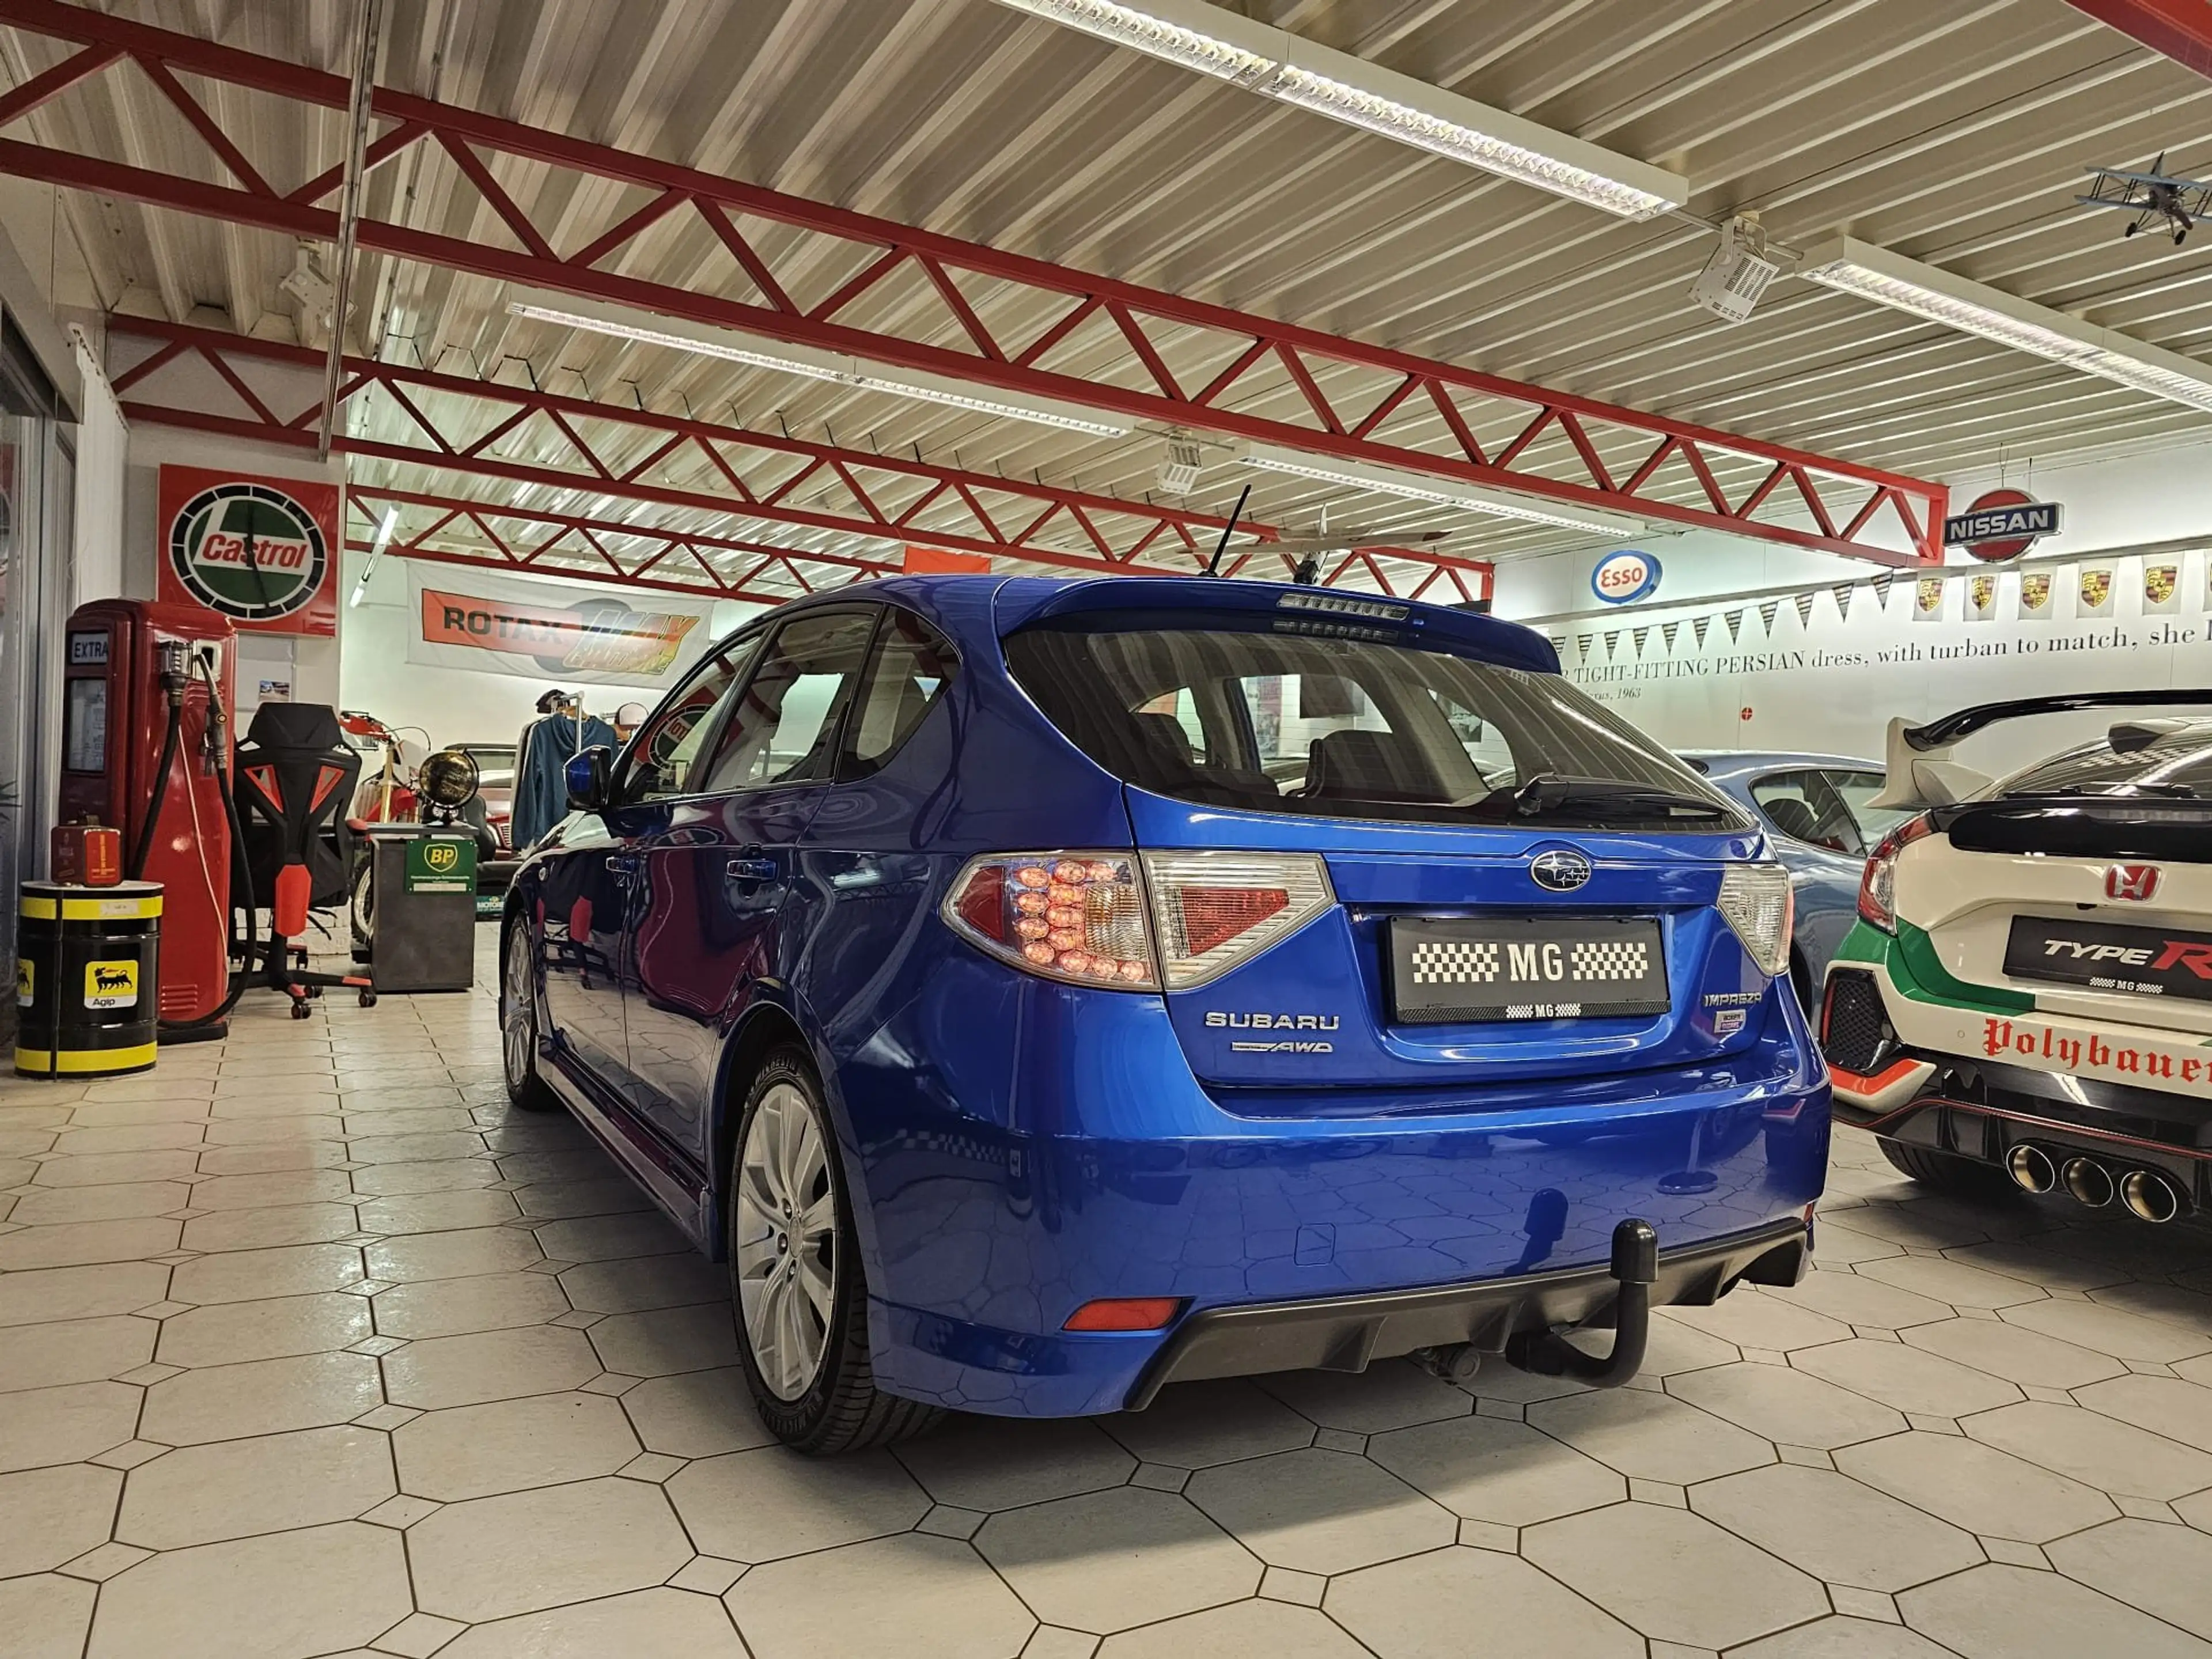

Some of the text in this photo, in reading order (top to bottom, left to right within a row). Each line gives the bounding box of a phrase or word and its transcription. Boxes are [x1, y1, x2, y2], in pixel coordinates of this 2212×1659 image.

[1950, 509, 2049, 540] NISSAN
[202, 534, 308, 569] Castrol
[443, 606, 562, 643] ROTAX
[74, 641, 108, 658] EXTRA
[1574, 658, 1709, 683] TIGHT-FITTING
[1715, 650, 1805, 675] PERSIAN
[1811, 649, 1869, 668] dress,
[1876, 639, 1922, 664] with
[1930, 632, 2008, 660] turban
[2017, 637, 2039, 654] to
[2048, 626, 2138, 652] match,
[2149, 623, 2195, 645] she
[430, 849, 454, 863] BP
[2044, 939, 2154, 965] TYPE
[1507, 943, 1564, 982] MG
[2116, 980, 2135, 991] MG
[92, 998, 116, 1006] Agip
[1705, 992, 1762, 1007] IMPREZA
[1535, 1004, 1554, 1017] MG
[1205, 1012, 1340, 1030] SUBARU
[1270, 1041, 1334, 1053] AWD
